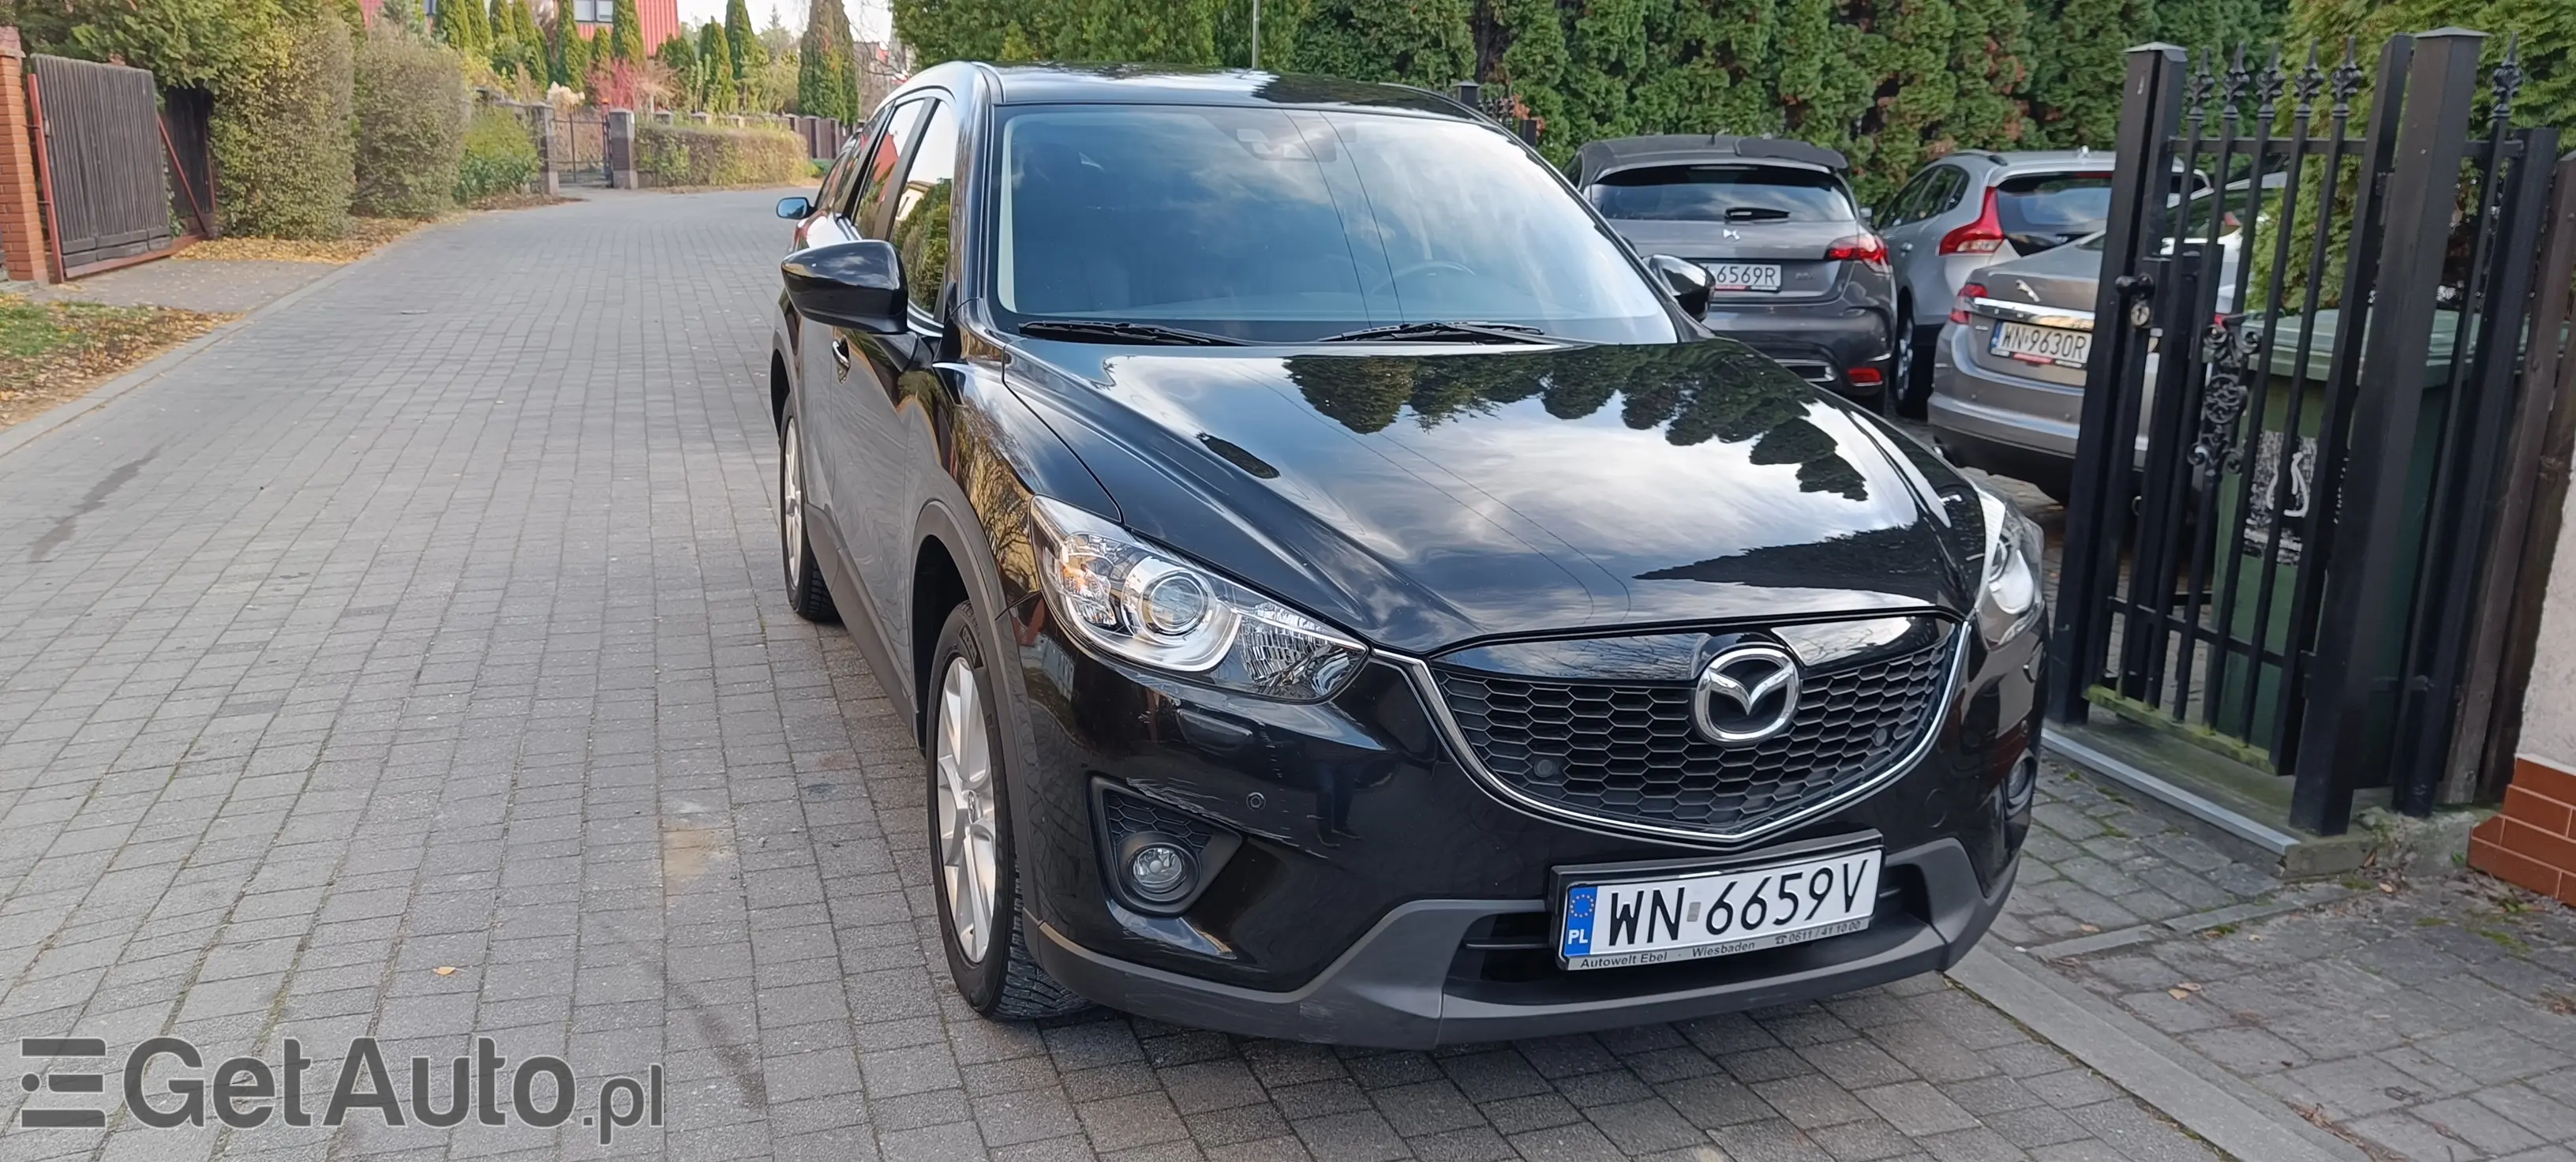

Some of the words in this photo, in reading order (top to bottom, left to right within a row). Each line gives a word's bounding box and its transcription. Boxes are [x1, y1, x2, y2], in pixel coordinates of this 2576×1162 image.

[1717, 265, 1776, 285] 6569R
[2001, 324, 2026, 350] WN
[2027, 330, 2087, 360] 9630R
[1608, 886, 1685, 946] WN
[1705, 860, 1868, 935] 6659V
[1567, 929, 1588, 945] PL
[1580, 955, 1637, 969] Autowelt
[1640, 951, 1668, 963] Ebel
[1692, 941, 1755, 958] Wiesbaden
[1788, 930, 1813, 943] 0611
[1822, 927, 1833, 937] 41
[1837, 924, 1848, 934] 10
